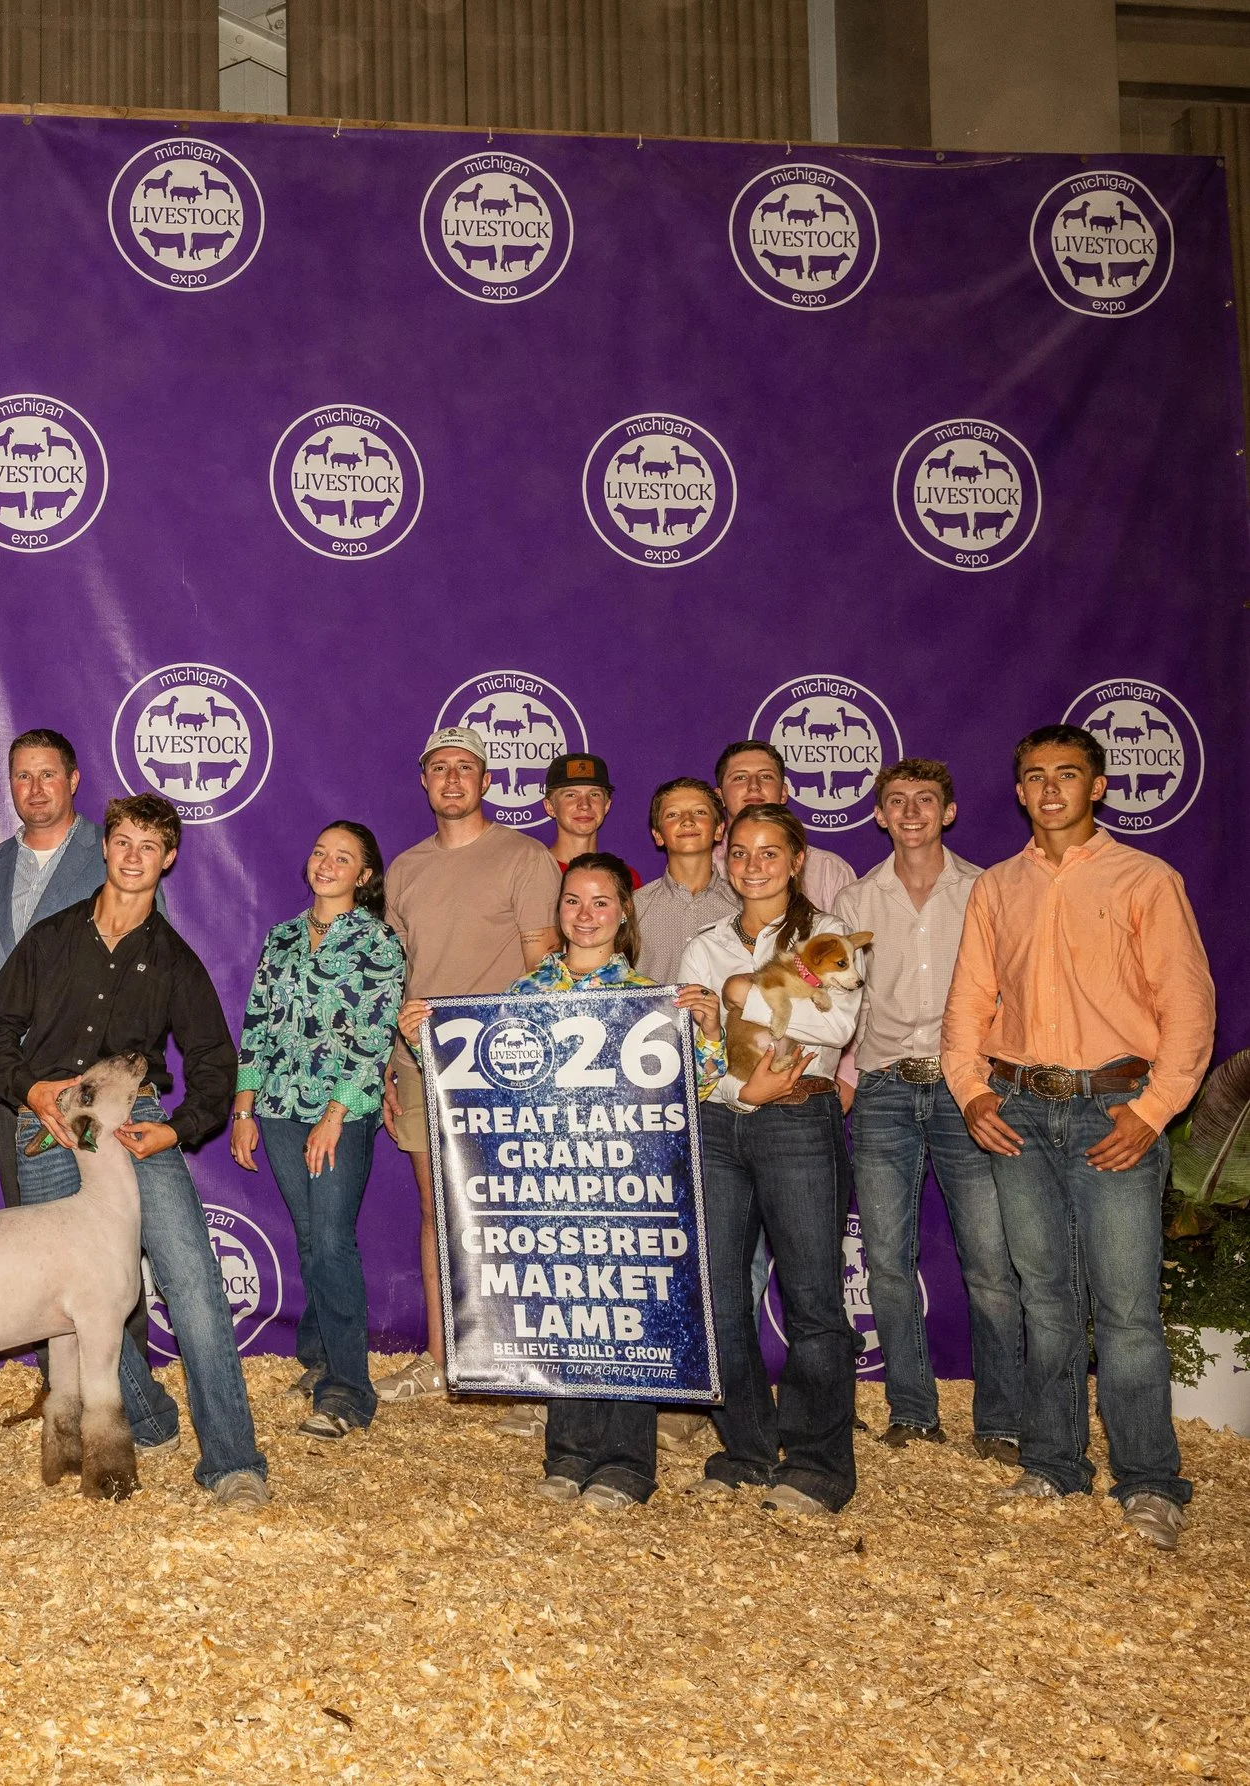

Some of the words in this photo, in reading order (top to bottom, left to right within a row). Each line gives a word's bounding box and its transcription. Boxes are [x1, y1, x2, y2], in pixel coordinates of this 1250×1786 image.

[154, 142, 220, 163] michigan
[464, 156, 529, 176] michigan
[771, 168, 835, 186] michigan
[1070, 175, 1134, 193] michigan
[133, 206, 240, 226] LIVESTOCK
[444, 220, 550, 238] LIVESTOCK
[752, 229, 856, 247] LIVESTOCK
[1054, 236, 1154, 254] LIVESTOCK
[171, 274, 206, 287] expo
[482, 286, 517, 299] expo
[792, 293, 826, 306] expo
[1092, 301, 1125, 314] expo
[314, 409, 380, 429] michigan
[626, 418, 692, 437] michigan
[934, 423, 999, 442] michigan
[294, 473, 400, 493] LIVESTOCK
[607, 482, 712, 500] LIVESTOCK
[917, 487, 1019, 505] LIVESTOCK
[12, 534, 48, 548] expo
[332, 542, 367, 556] expo
[645, 550, 680, 563] expo
[956, 553, 988, 567] expo
[160, 668, 227, 688] michigan
[477, 675, 543, 695] michigan
[791, 679, 856, 699] michigan
[1096, 683, 1160, 702] michigan
[137, 736, 248, 754] LIVESTOCK
[784, 745, 879, 763] IVESTOCK
[176, 805, 213, 820] expo
[496, 810, 532, 824] expo
[812, 814, 848, 827] expo
[1119, 816, 1152, 829] expo
[490, 1050, 542, 1060] LIVESTOCK
[446, 1107, 556, 1134] GREAT
[568, 1104, 686, 1131] LAKES
[497, 1141, 634, 1168] GRAND
[466, 1175, 673, 1204] CHAMPION
[461, 1227, 688, 1257] CROSSBRED
[480, 1264, 674, 1300] MARKET
[513, 1305, 644, 1341] LAMB
[493, 1342, 558, 1357] BELIEVE
[568, 1344, 615, 1358] BUILD
[624, 1347, 671, 1360] GROW
[566, 1365, 593, 1375] OUR
[593, 1366, 677, 1379] AGRICULTURE
